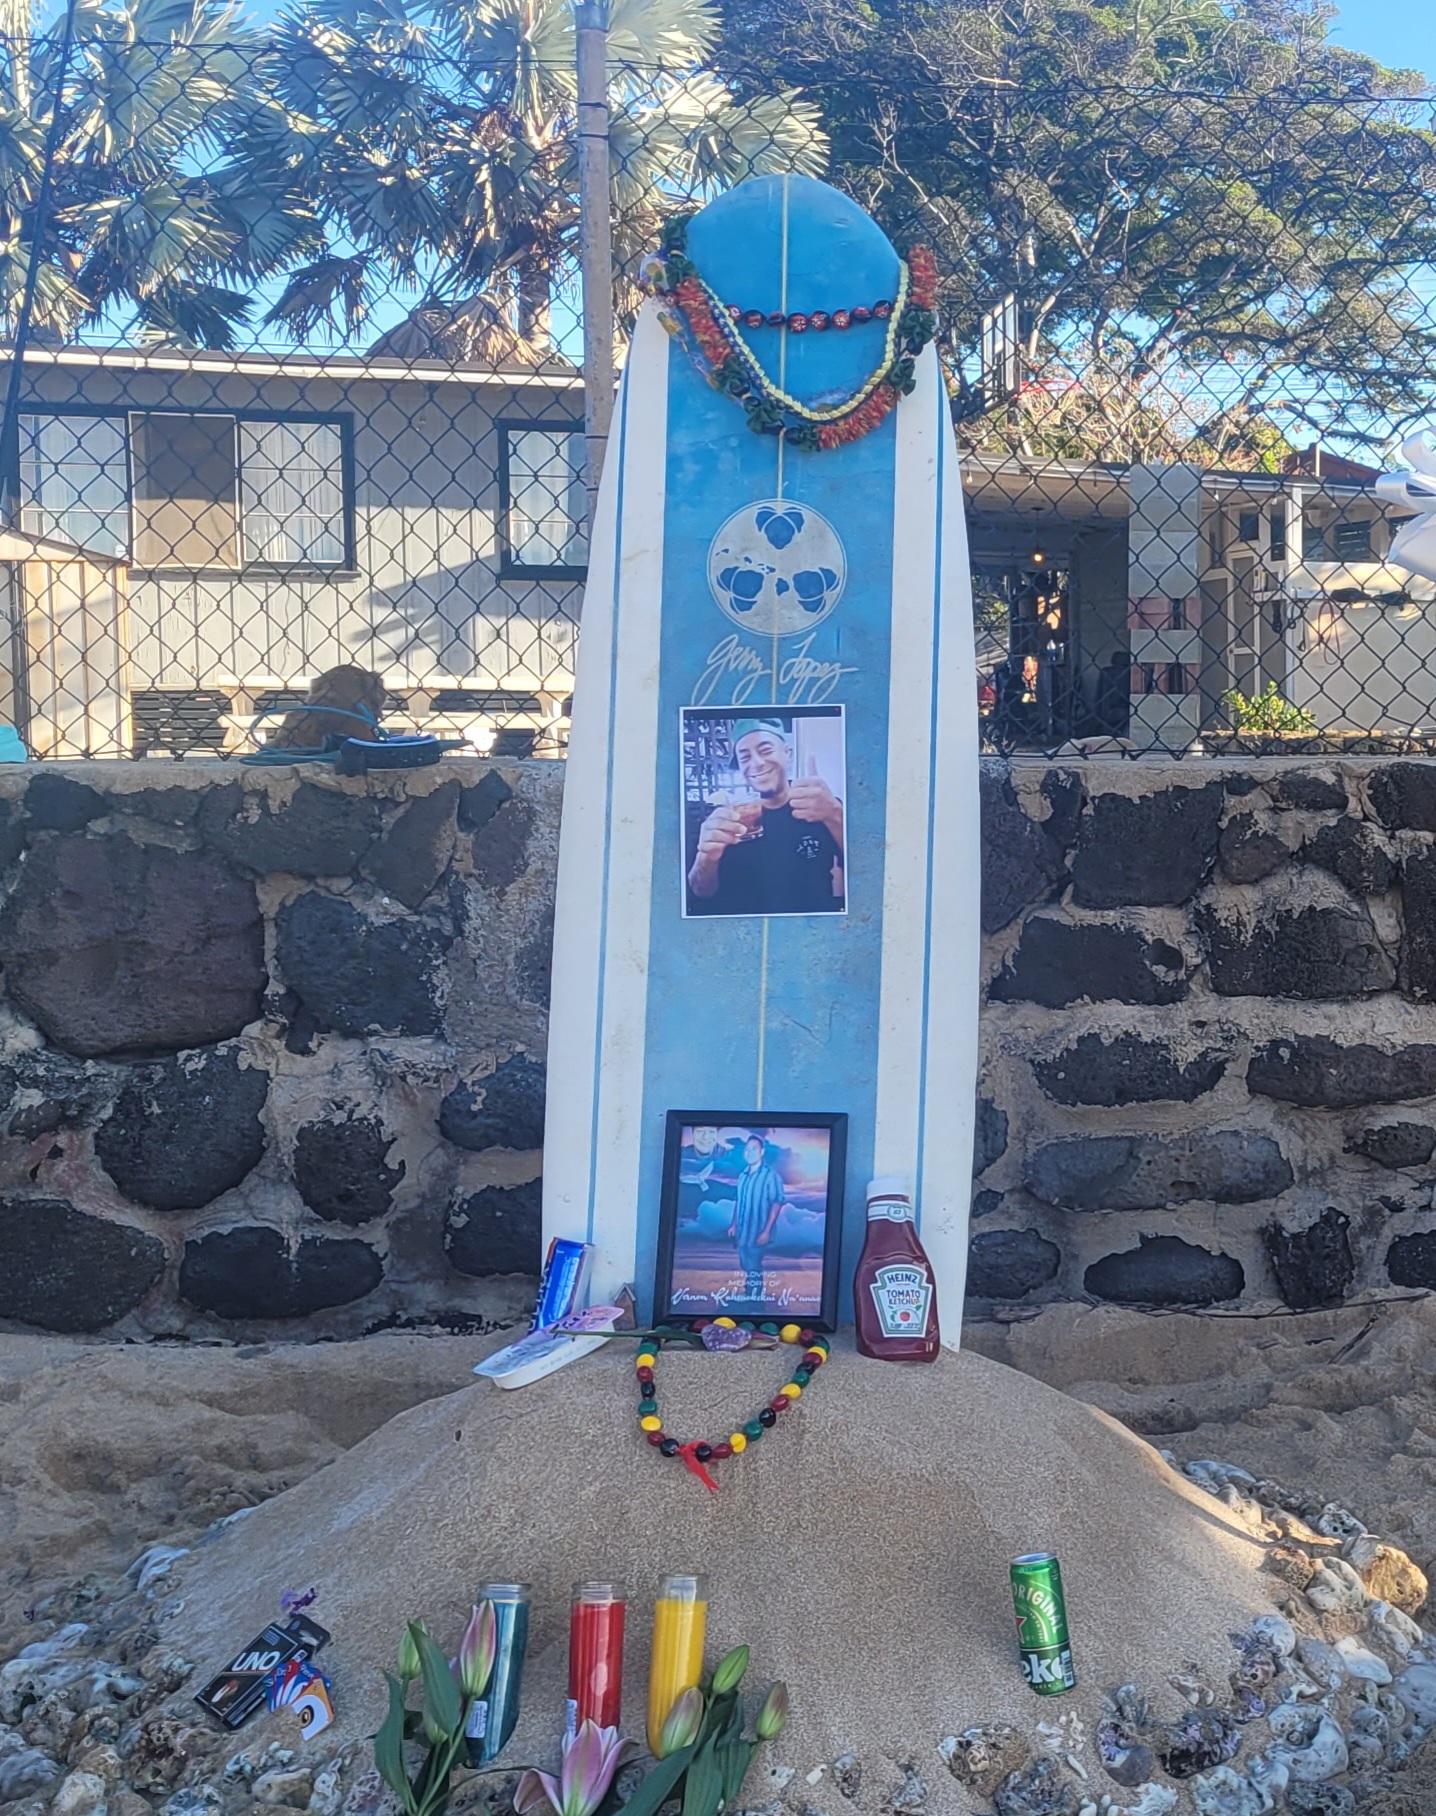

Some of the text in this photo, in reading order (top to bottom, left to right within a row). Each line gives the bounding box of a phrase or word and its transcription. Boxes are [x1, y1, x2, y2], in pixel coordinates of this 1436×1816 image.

[887, 1273, 918, 1284] HEINZ
[887, 1290, 920, 1298] TOMATO
[231, 1651, 281, 1671] UNO
